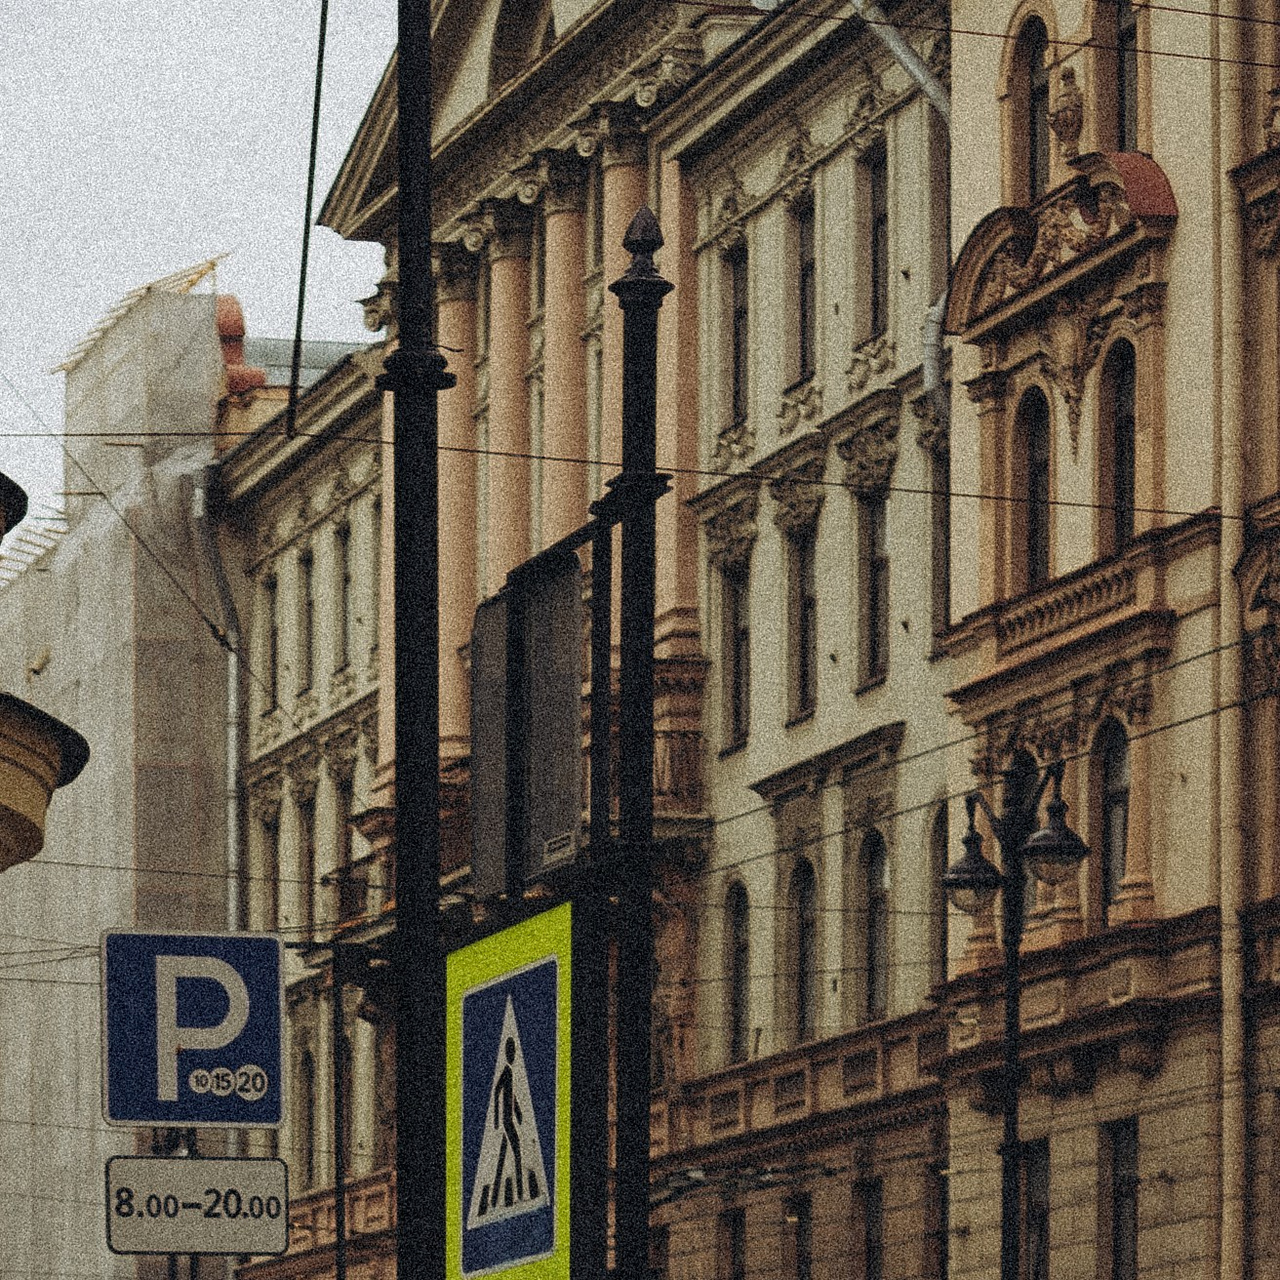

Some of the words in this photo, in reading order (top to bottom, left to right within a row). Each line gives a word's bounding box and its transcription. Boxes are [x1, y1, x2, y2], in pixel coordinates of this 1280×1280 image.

[155, 955, 250, 1101] P
[193, 1073, 209, 1088] 10
[214, 1072, 232, 1091] 15
[237, 1071, 266, 1094] 20
[114, 1186, 282, 1219] 8.00-20.00
